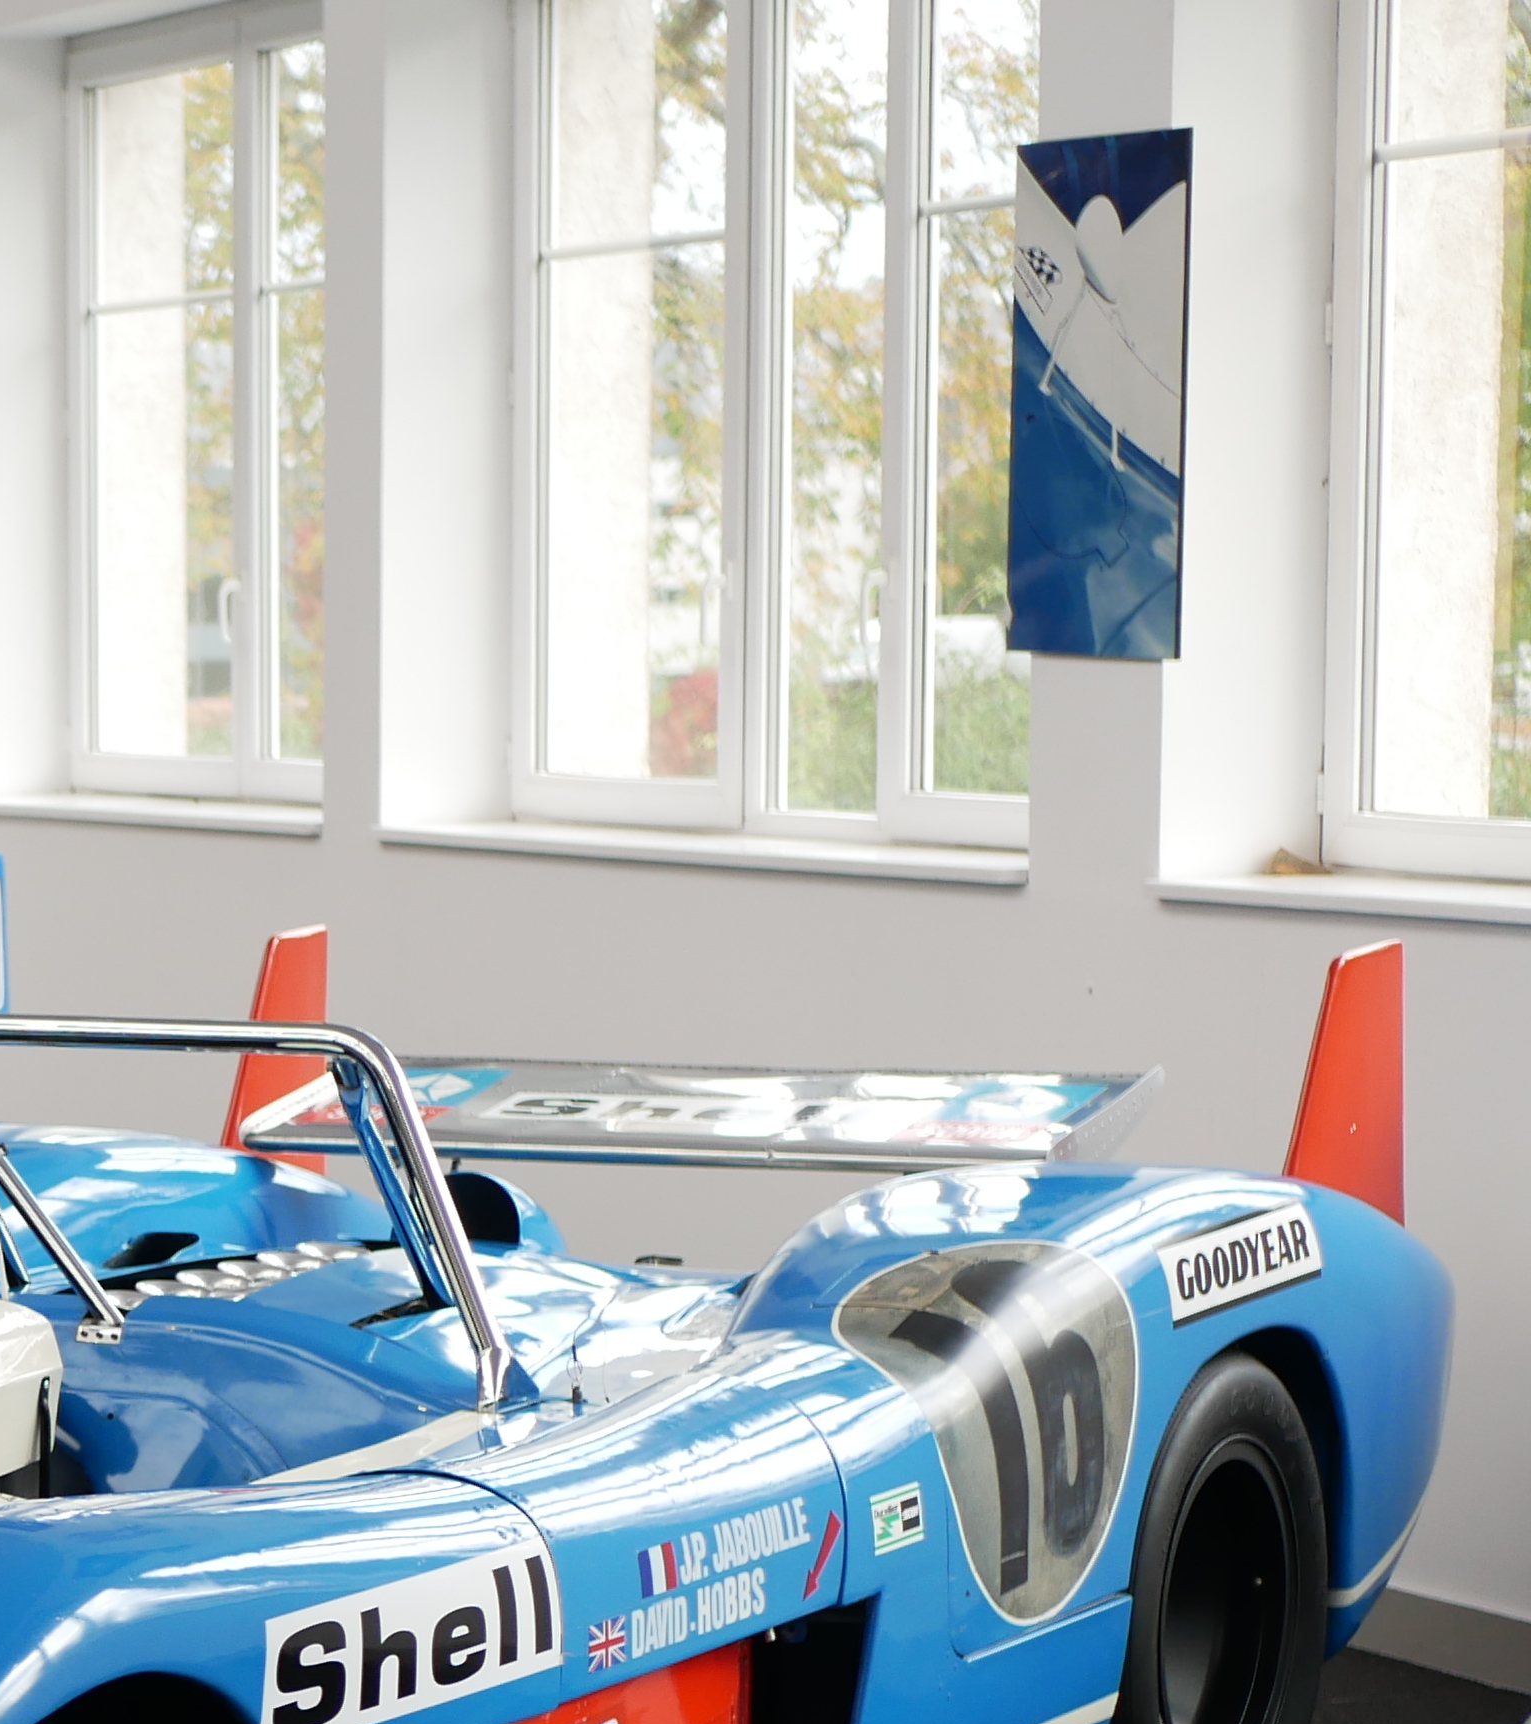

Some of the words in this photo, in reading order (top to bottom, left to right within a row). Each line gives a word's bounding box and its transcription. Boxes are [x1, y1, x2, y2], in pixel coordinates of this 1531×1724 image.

[1176, 1219, 1310, 1302] GOODYEAR
[680, 1531, 709, 1586] J.P.
[712, 1496, 811, 1574] JABOUILLE
